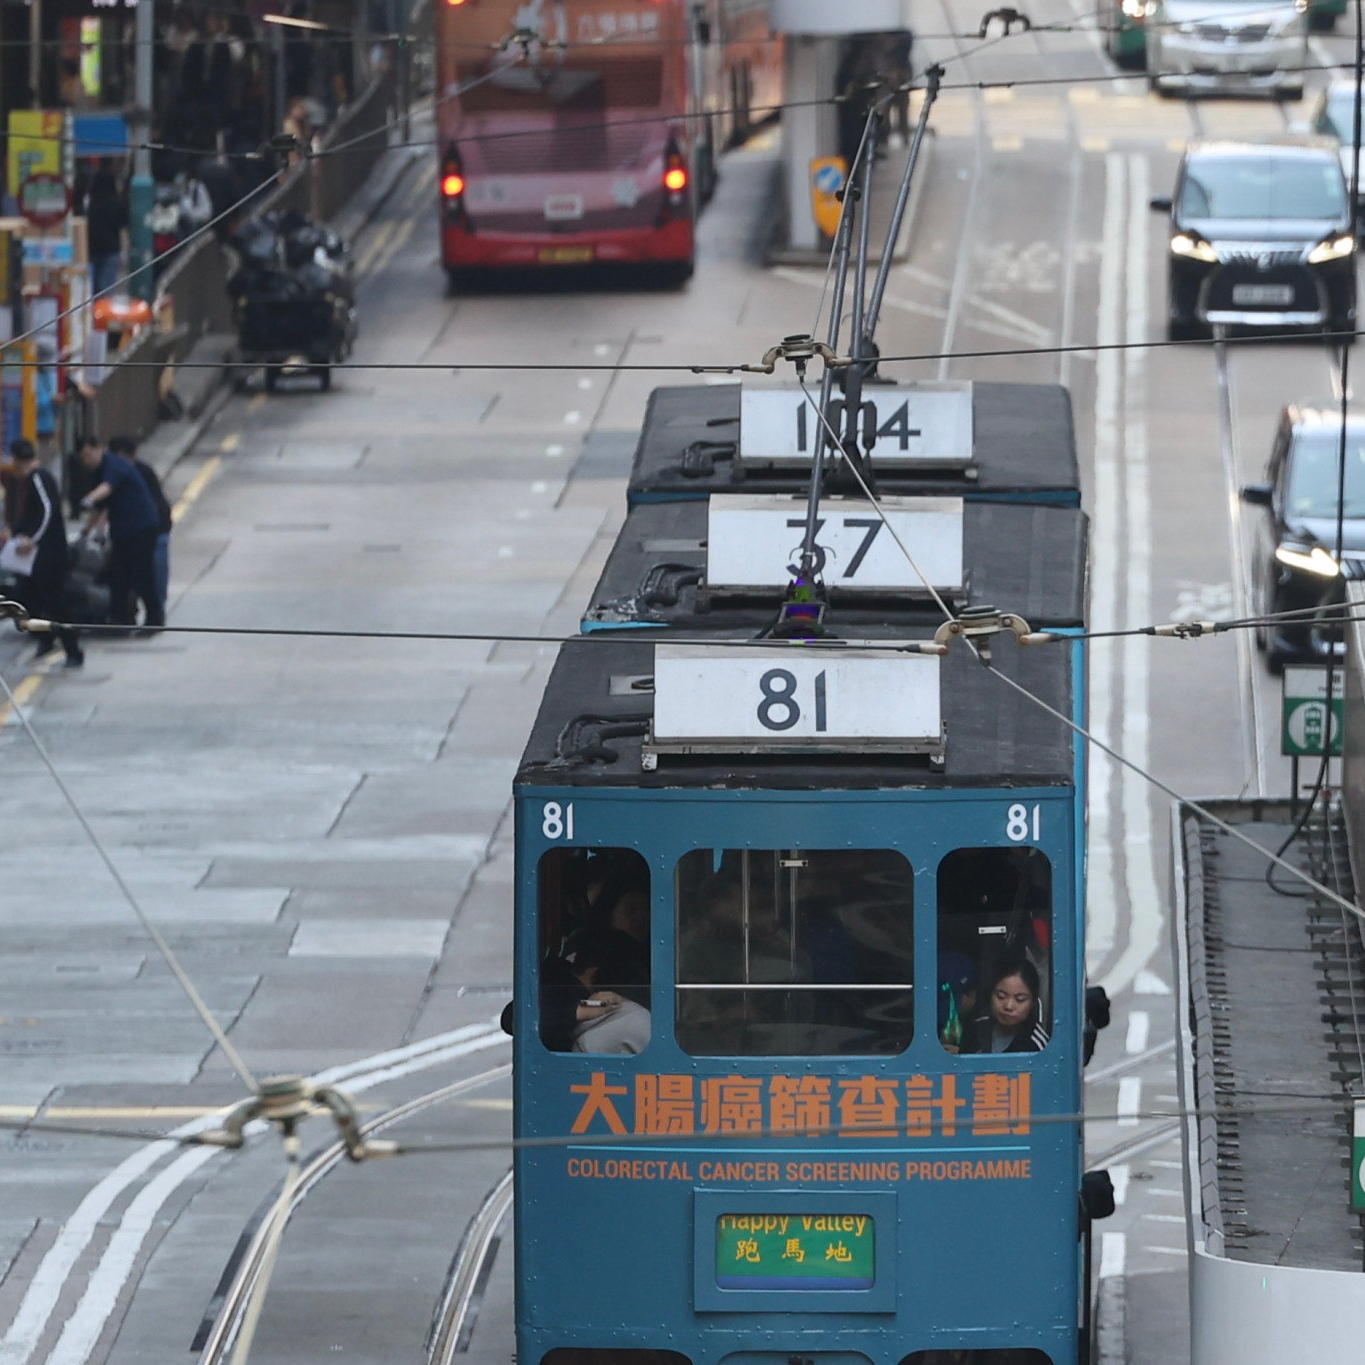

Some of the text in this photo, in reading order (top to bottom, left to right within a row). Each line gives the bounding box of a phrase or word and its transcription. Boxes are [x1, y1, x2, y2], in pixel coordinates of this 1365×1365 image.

[756, 667, 828, 732] 81
[542, 801, 574, 840] 81
[1006, 803, 1041, 842] 81
[569, 1072, 1031, 1138] 大腸癌篩查計劃
[567, 1159, 1032, 1182] COLORECTAL CANCER SCREENING PROGRAMME
[735, 1238, 853, 1263] 跑馬地
